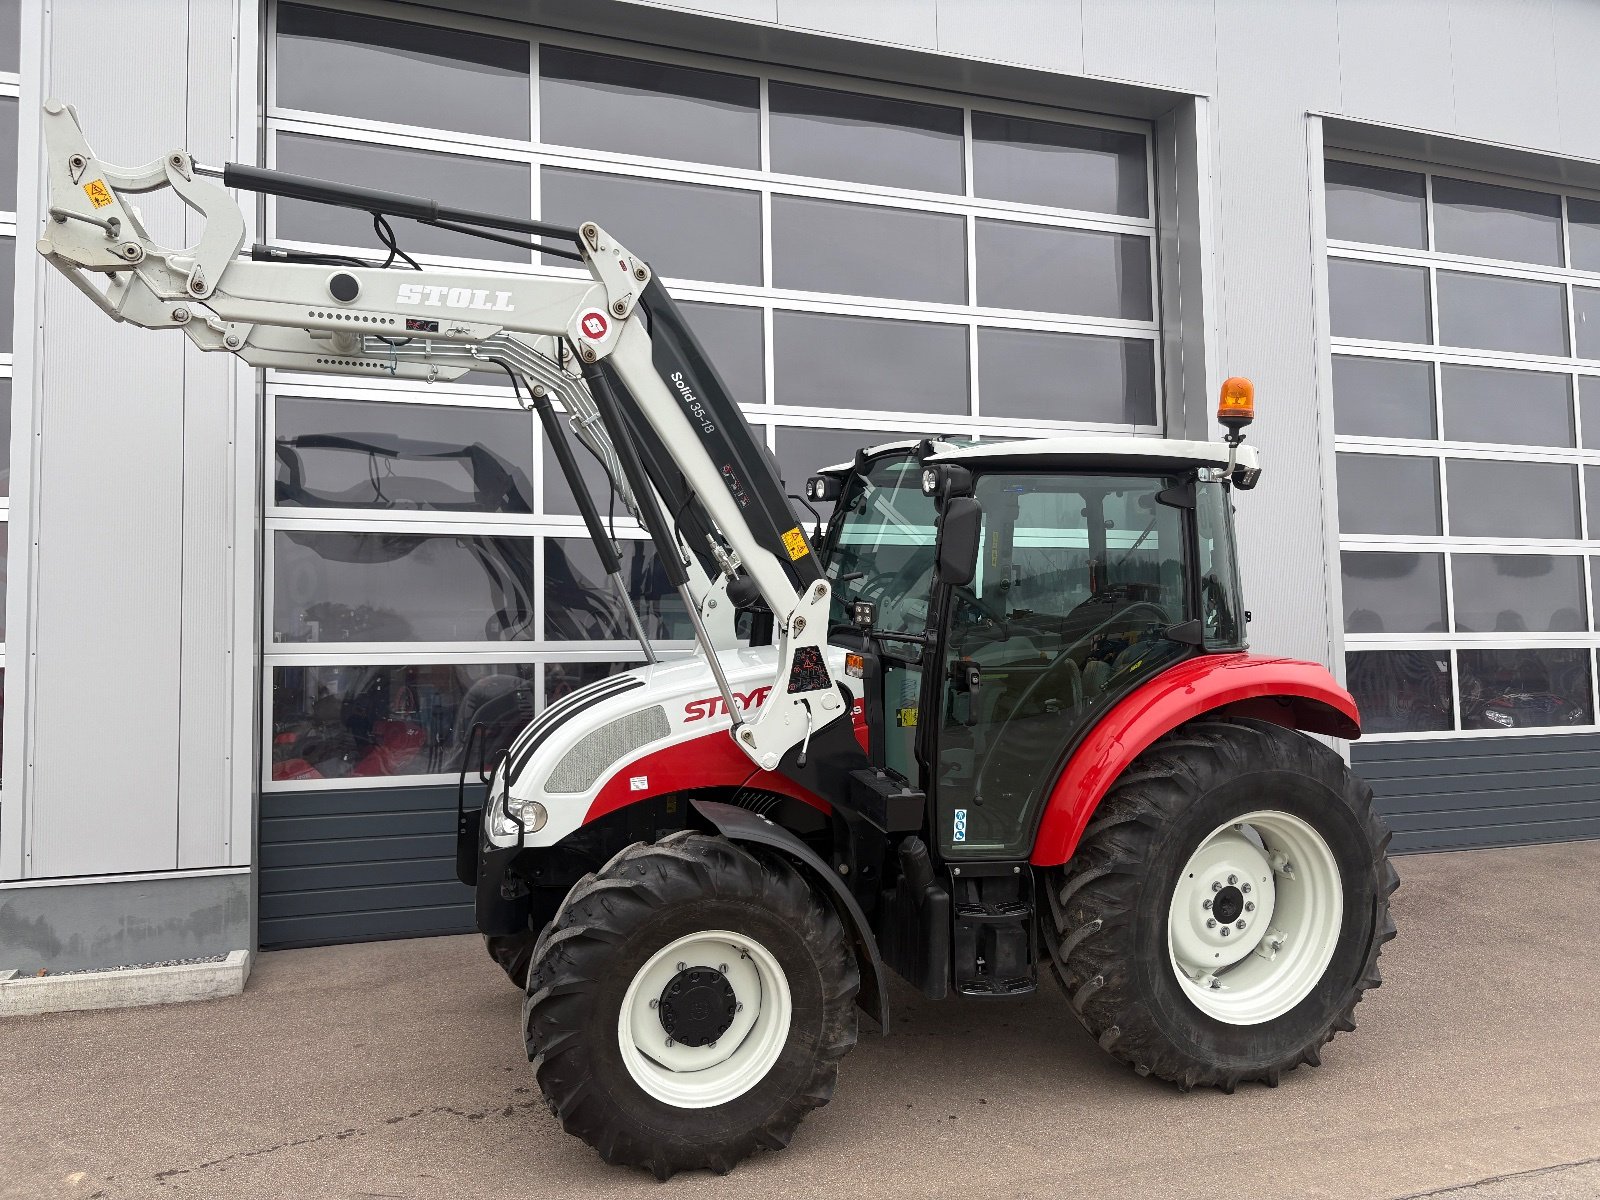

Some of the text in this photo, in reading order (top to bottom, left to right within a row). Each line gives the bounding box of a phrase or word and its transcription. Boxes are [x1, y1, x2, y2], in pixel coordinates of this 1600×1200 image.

[396, 283, 515, 312] STOLL
[671, 371, 715, 434] Solid 35-18
